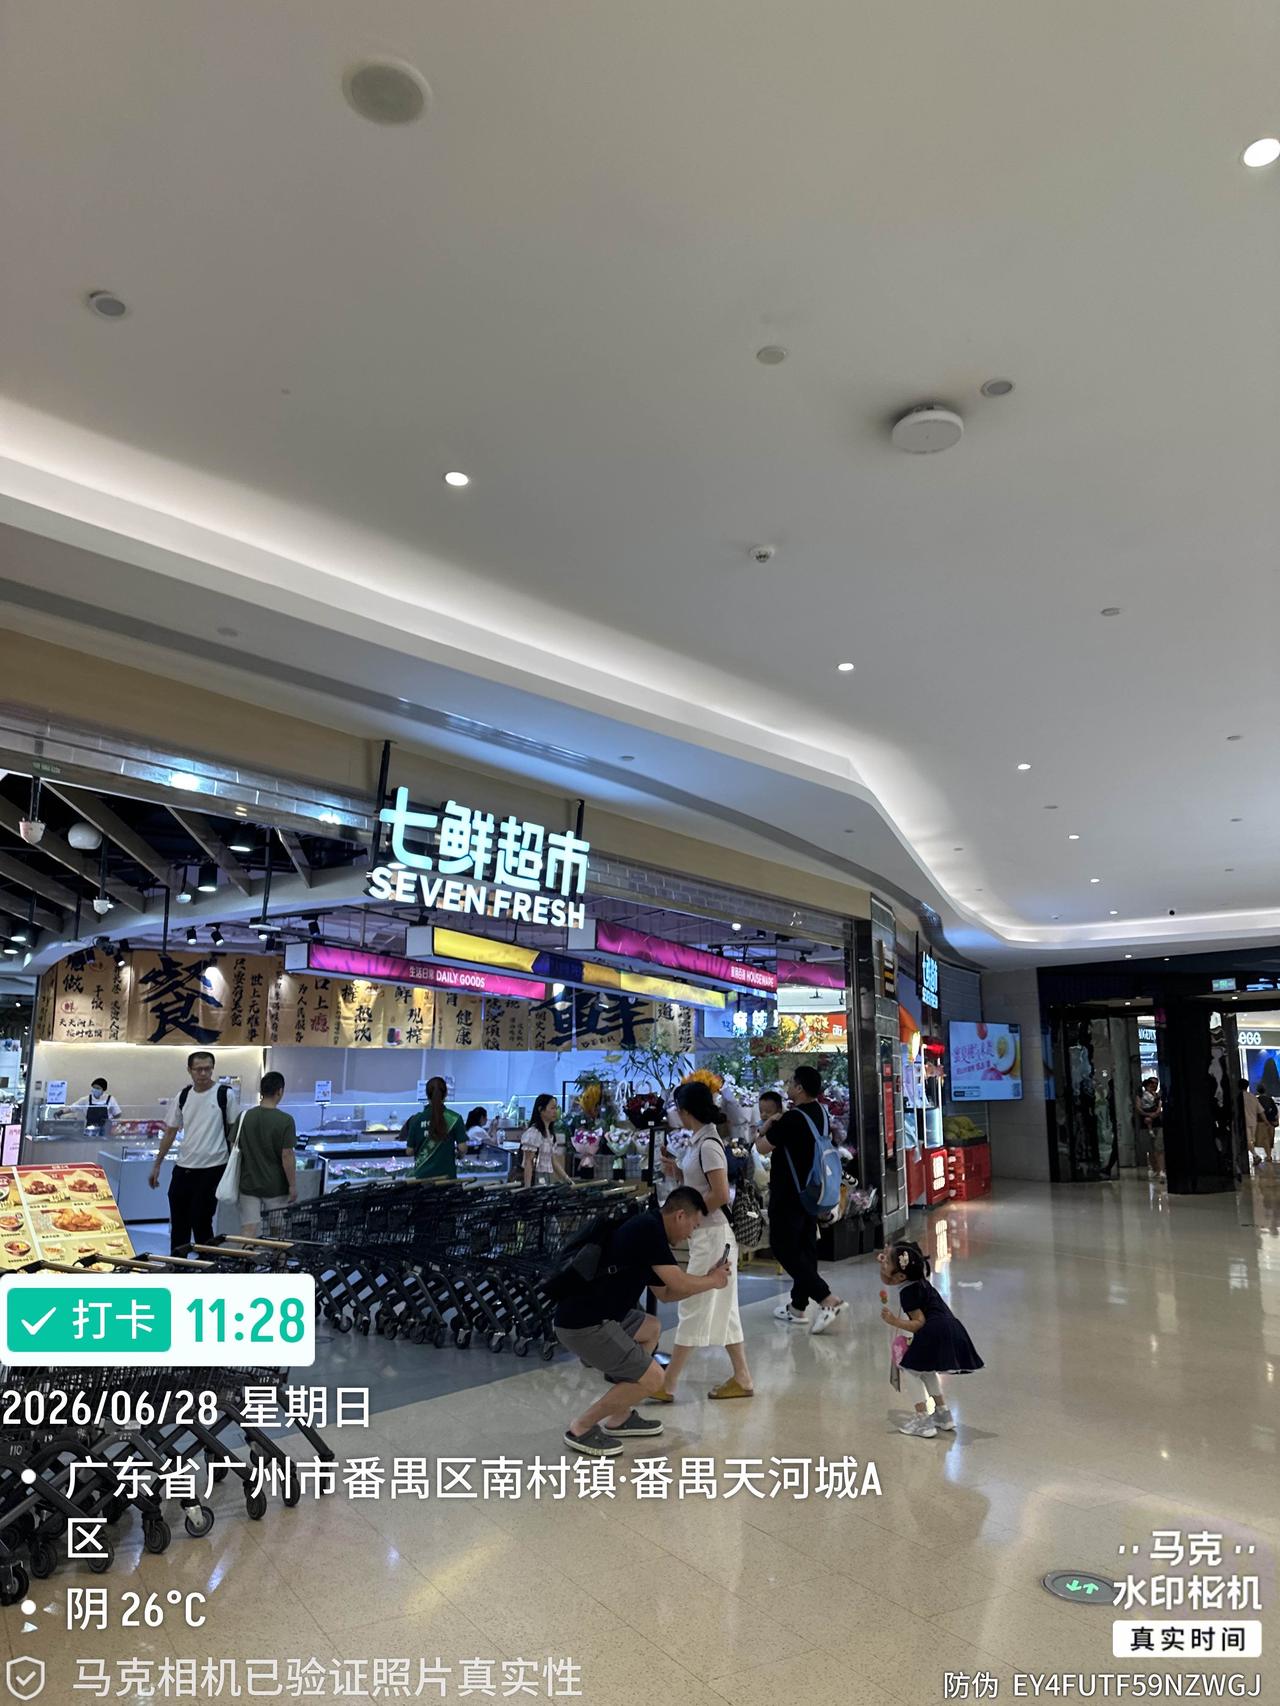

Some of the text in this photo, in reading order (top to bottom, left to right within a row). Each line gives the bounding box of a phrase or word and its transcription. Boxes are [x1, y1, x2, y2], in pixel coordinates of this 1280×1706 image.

[379, 786, 590, 897] 七鲜超市
[367, 866, 586, 930] SEVEN FRESH
[138, 955, 223, 1045] 餐
[436, 969, 459, 983] DAILY
[460, 973, 486, 988] GOODS
[456, 1008, 473, 1046] 健康
[529, 984, 657, 1051] 鲜
